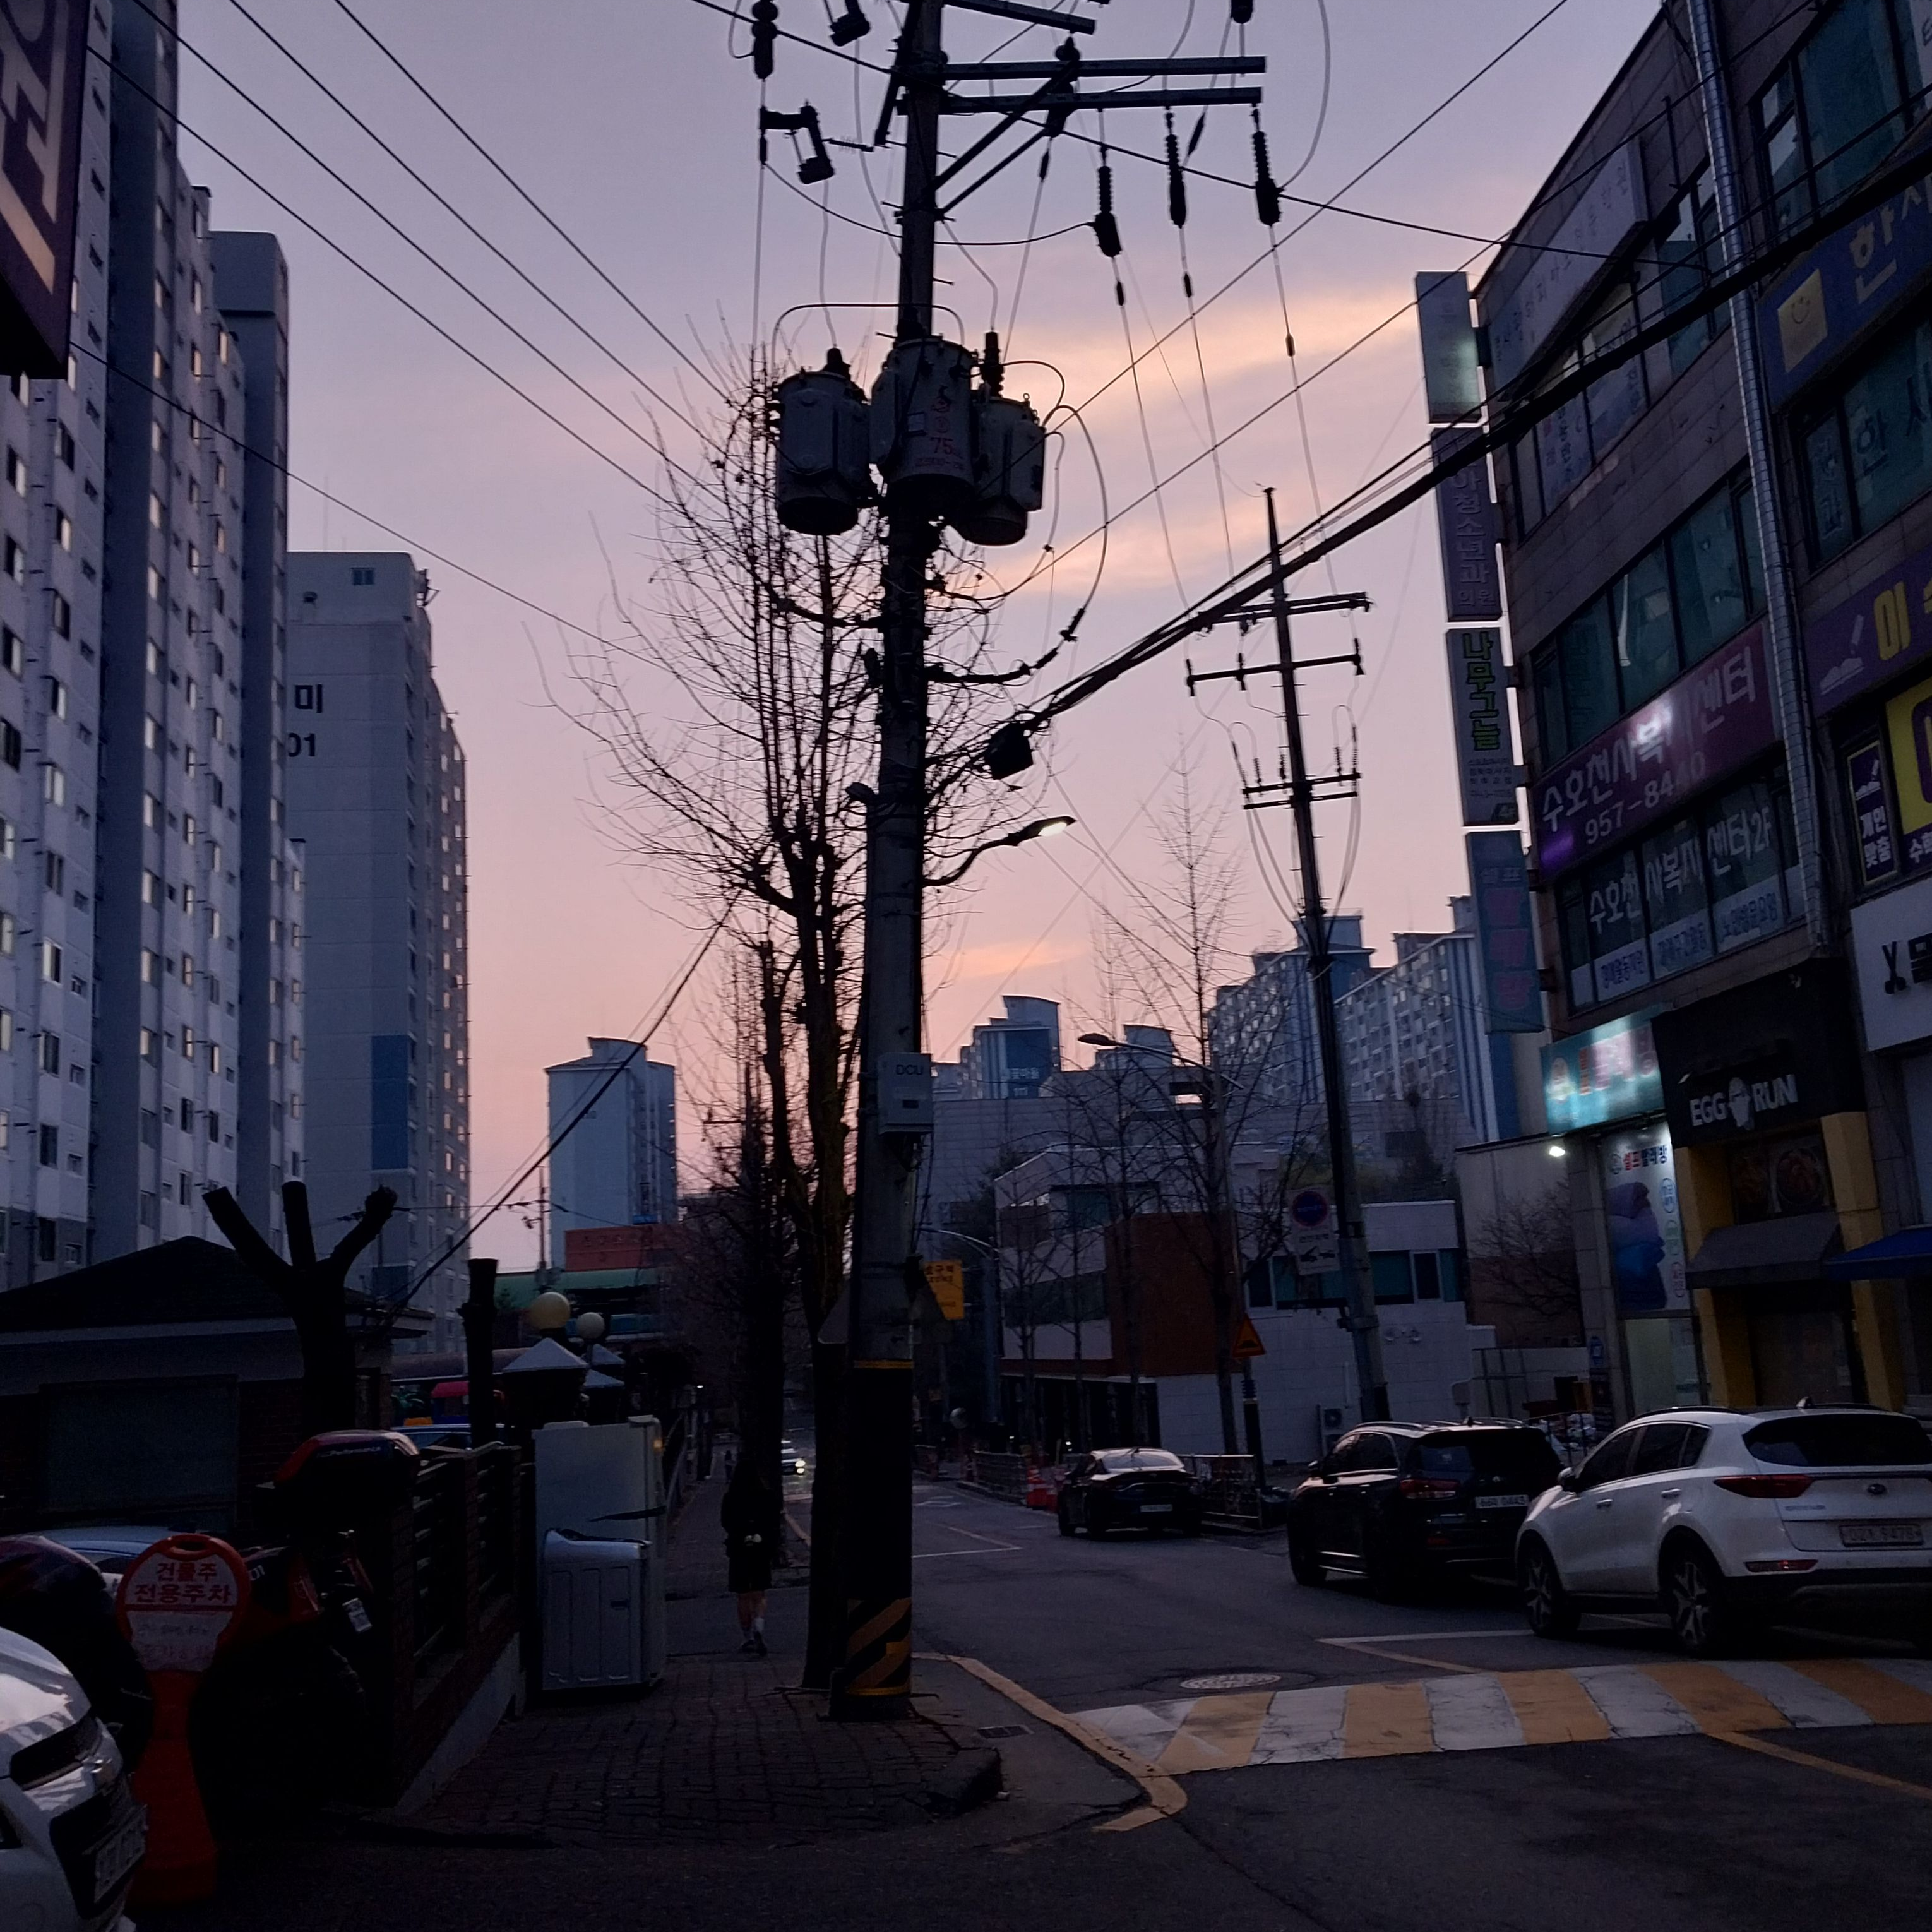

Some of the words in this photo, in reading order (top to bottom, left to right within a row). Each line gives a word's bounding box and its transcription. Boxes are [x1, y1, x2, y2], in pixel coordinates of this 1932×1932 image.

[1462, 631, 1500, 751] 나무그늘
[895, 1064, 924, 1076] DCU
[1688, 1092, 1728, 1127] EGG
[1753, 1073, 1799, 1113] RUN
[157, 1562, 217, 1582] 건물주
[134, 1583, 232, 1604] 전용주차
